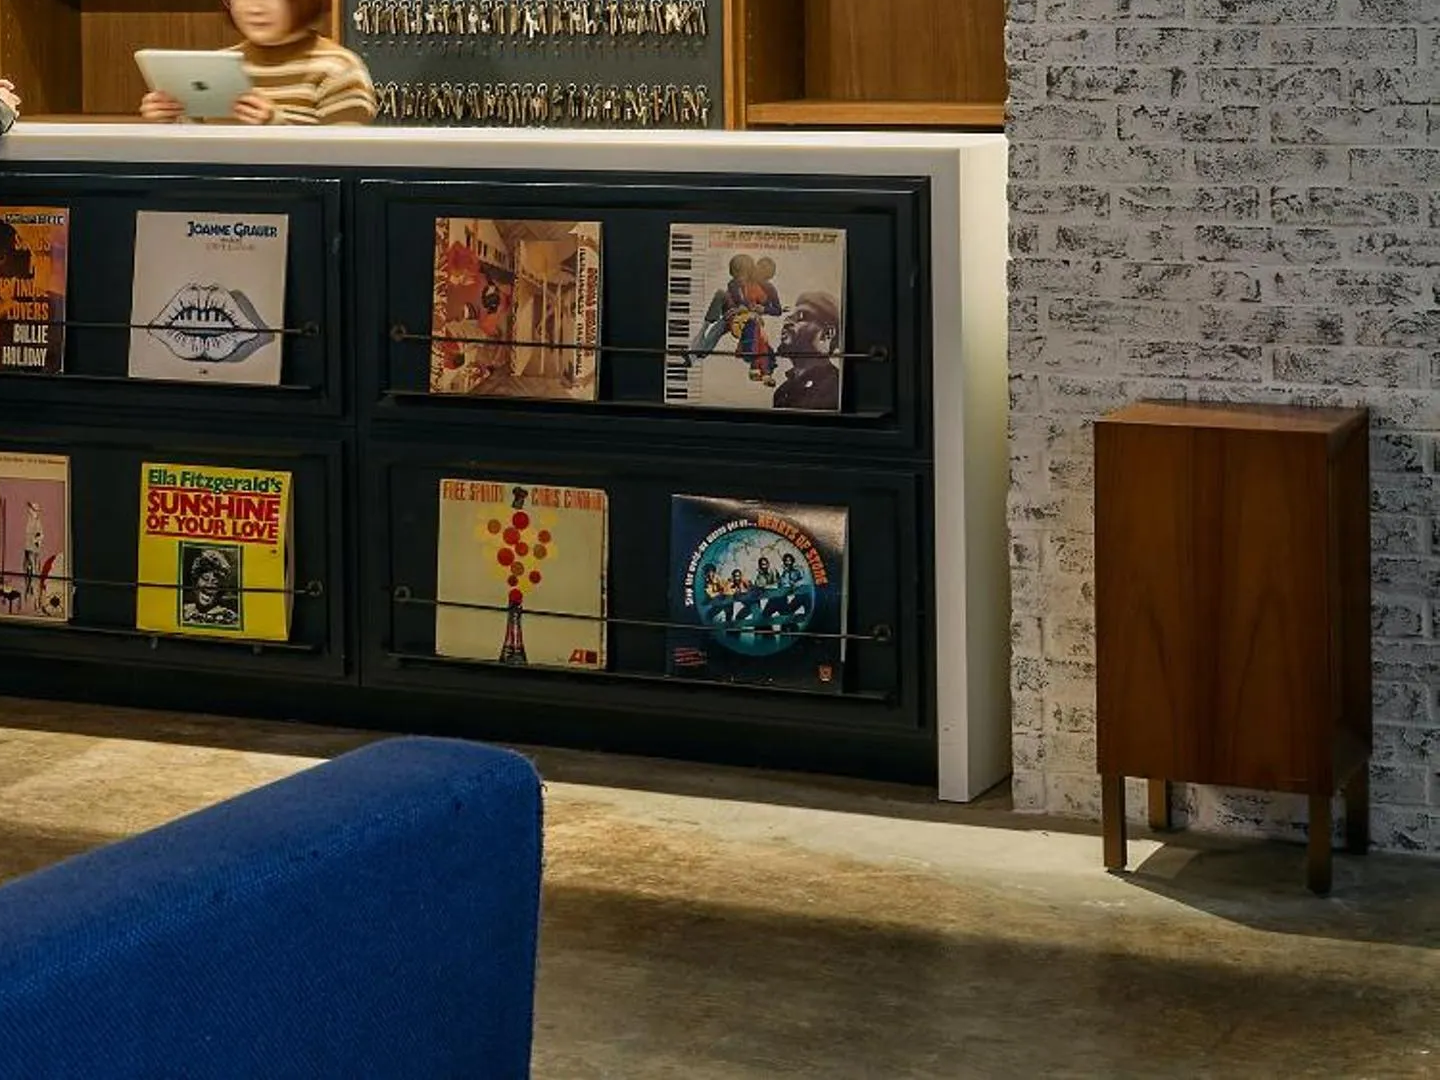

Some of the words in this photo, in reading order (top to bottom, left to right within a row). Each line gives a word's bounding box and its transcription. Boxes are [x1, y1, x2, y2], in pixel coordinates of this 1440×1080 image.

[187, 221, 231, 237] JOANNE
[13, 324, 48, 344] BILLIE
[2, 346, 48, 367] HOLIDAY
[148, 469, 177, 485] Ella
[181, 472, 283, 493] Fitzgerald's
[147, 490, 281, 521] SUNSHINE
[146, 515, 169, 530] OF
[176, 516, 226, 535] YOUR
[232, 522, 278, 539] LOVE
